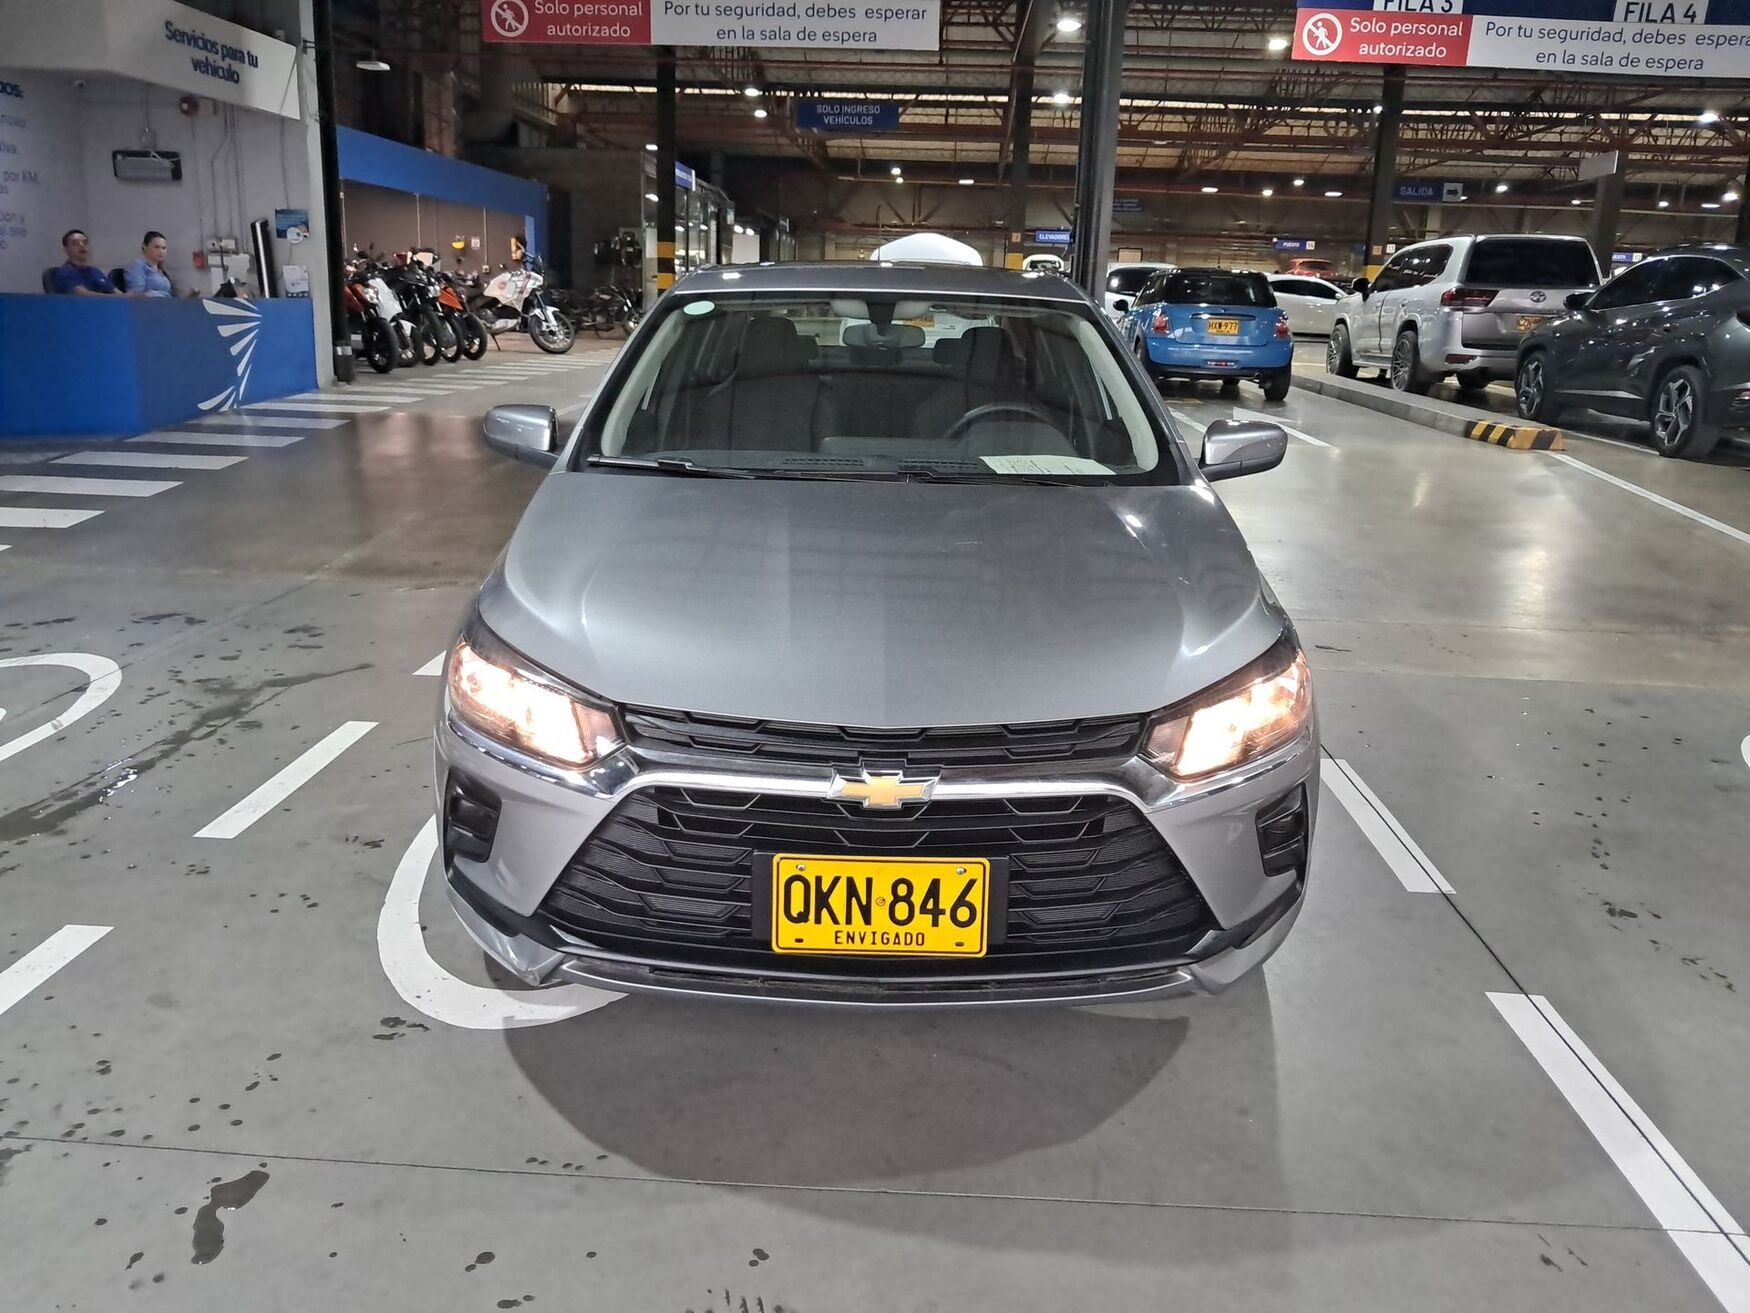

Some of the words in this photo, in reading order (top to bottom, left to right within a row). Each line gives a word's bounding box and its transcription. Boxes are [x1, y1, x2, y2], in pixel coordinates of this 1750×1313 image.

[535, 0, 570, 15] Solo
[574, 2, 643, 17] personal
[664, 1, 690, 16] Por
[694, 3, 710, 16] tu
[715, 3, 801, 20] seguridad,
[805, 3, 856, 19] debes
[864, 7, 927, 22] esperar
[1624, 2, 1675, 23] FILA
[1683, 3, 1697, 24] 4
[547, 23, 631, 37] autorizado
[716, 29, 737, 40] en
[742, 25, 755, 40] la
[760, 26, 791, 41] sala
[796, 26, 817, 42] de
[822, 30, 877, 45] espera
[1350, 17, 1386, 33] Solo
[1390, 21, 1463, 37] personal
[1485, 21, 1513, 38] Por
[1517, 24, 1533, 39] tu
[1537, 26, 1626, 45] seguridad,
[1632, 29, 1686, 45] debes
[165, 20, 219, 56] Servicios
[221, 44, 246, 64] para
[246, 49, 259, 68] tu
[1359, 42, 1447, 58] autorizado
[1536, 52, 1557, 64] en
[1562, 49, 1576, 65] la
[1581, 51, 1613, 67] sala
[1619, 53, 1641, 68] de
[1645, 57, 1704, 72] espera
[816, 104, 840, 114] SOLO
[842, 104, 881, 115] INGRESO
[823, 113, 873, 125] VEHÍCULOS
[1400, 186, 1434, 196] SALIDA
[783, 874, 873, 926] QKN
[888, 878, 978, 929] 846
[834, 930, 926, 947] ENVIGADO
